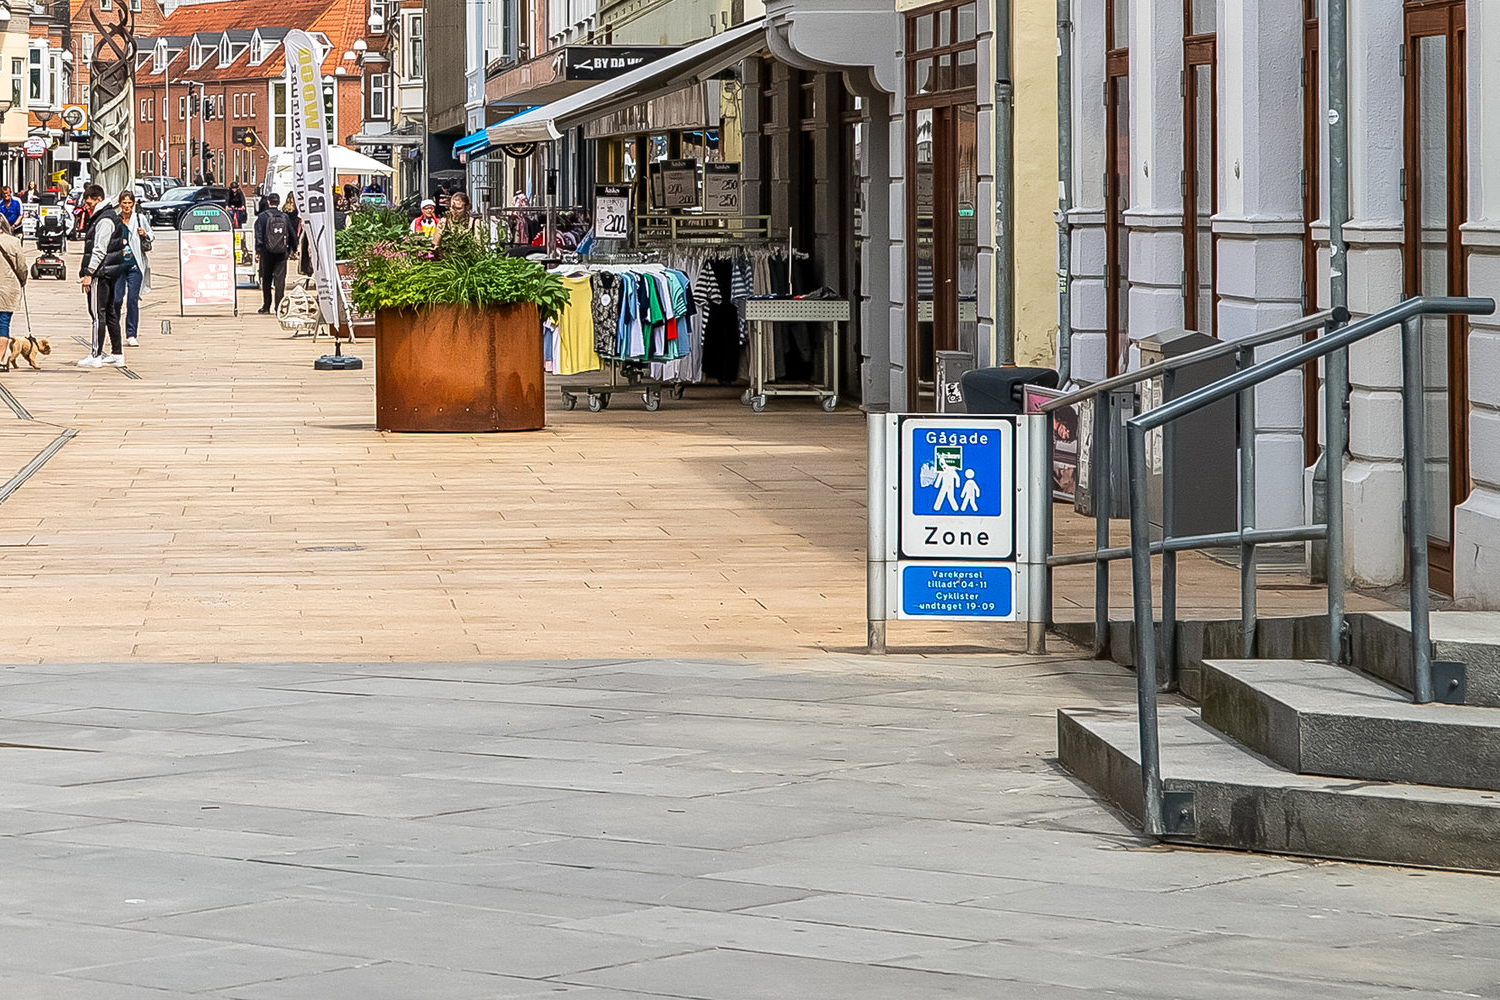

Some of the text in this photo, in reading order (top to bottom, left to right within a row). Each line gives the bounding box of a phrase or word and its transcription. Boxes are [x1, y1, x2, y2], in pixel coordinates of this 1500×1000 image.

[594, 58, 608, 68] BY
[610, 58, 625, 68] DA
[926, 431, 988, 446] Gågade
[924, 526, 990, 545] Zone
[932, 570, 983, 579] Varekørsel
[927, 580, 987, 588] tilladt 04-11
[935, 592, 979, 601] Cyklister
[920, 602, 995, 611] undtaget 19-09
